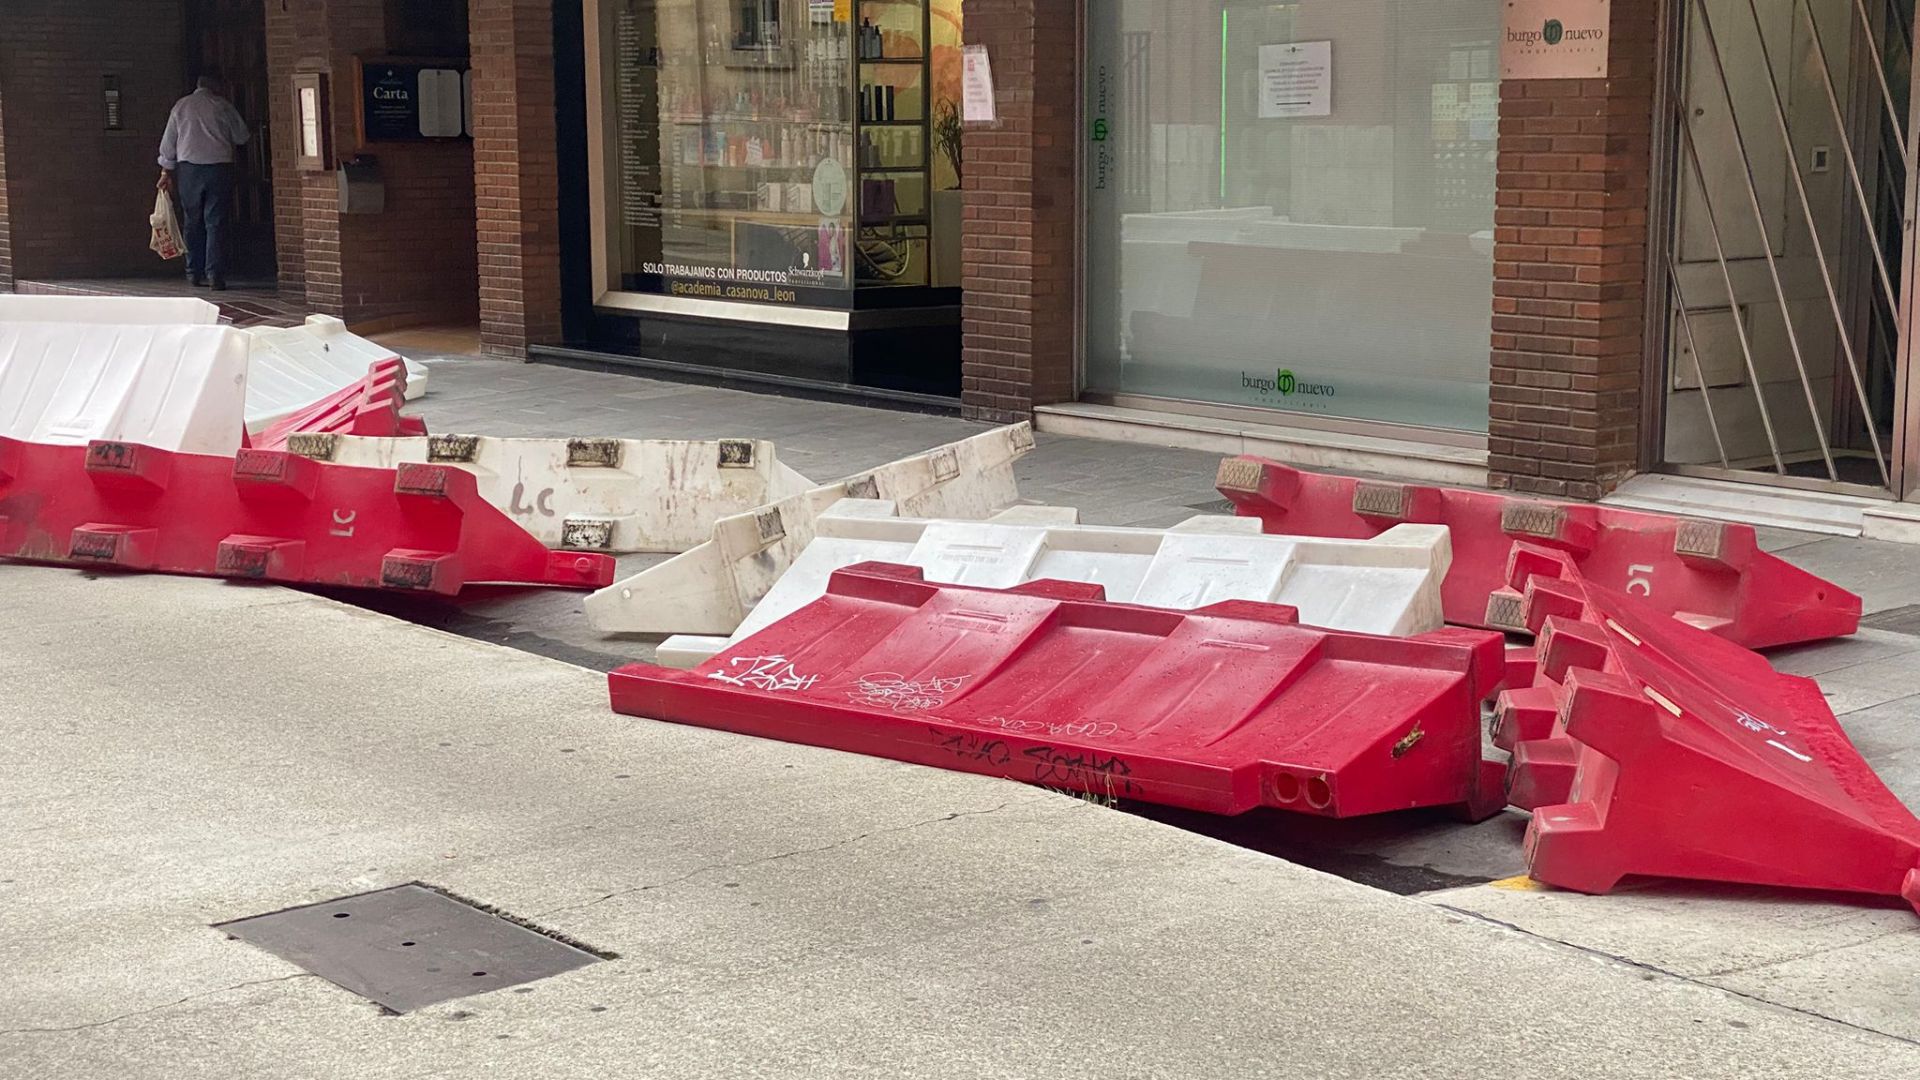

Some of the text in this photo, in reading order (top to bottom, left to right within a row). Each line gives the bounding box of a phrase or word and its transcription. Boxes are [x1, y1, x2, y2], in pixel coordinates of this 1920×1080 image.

[1507, 26, 1541, 46] burgo
[1565, 28, 1603, 40] nuevo
[373, 86, 408, 100] Carta
[1095, 144, 1109, 190] burgo
[643, 262, 664, 275] SOLO
[665, 264, 716, 278] TRABAJAMOS
[717, 269, 735, 280] CON
[736, 269, 787, 283] PRODUCTOS
[671, 280, 796, 302] @academia_casanova_leon
[1242, 371, 1275, 395] burgo
[1297, 382, 1335, 397] nuevo
[510, 482, 555, 517] LC
[329, 508, 356, 537] LC
[1626, 564, 1654, 597] LC
